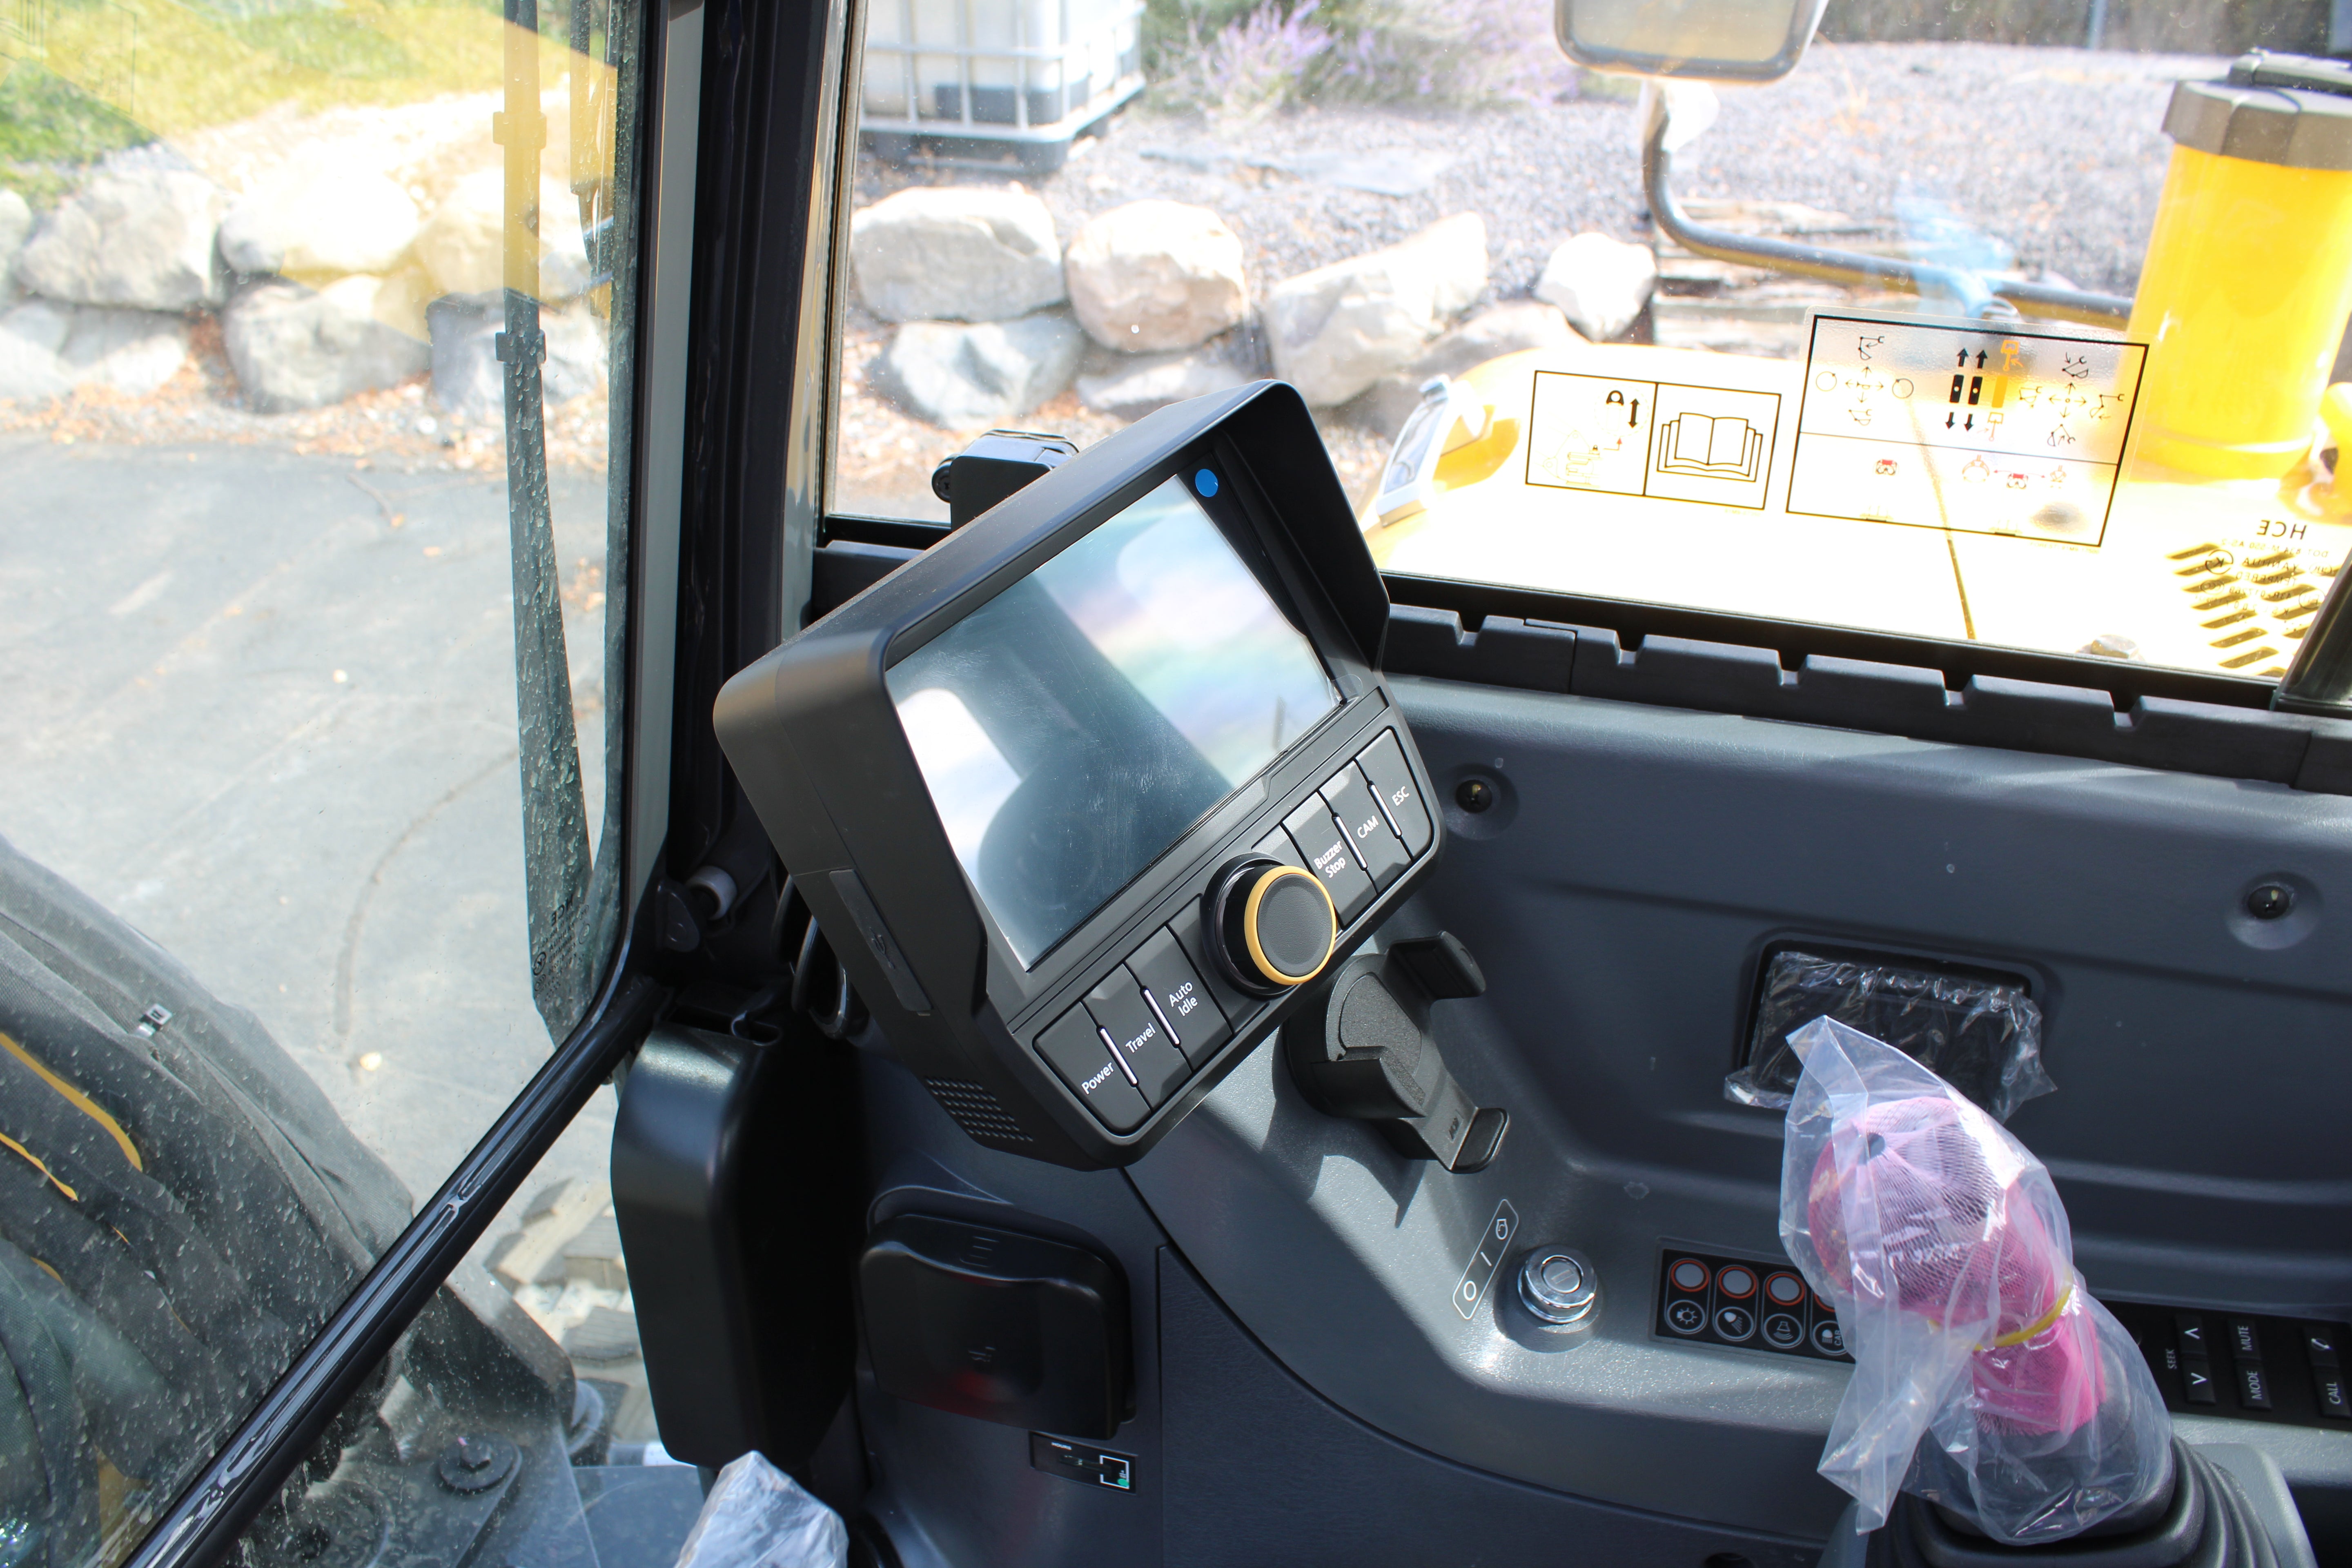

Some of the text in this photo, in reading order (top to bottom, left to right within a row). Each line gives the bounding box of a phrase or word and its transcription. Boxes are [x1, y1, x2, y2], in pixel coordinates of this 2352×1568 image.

[1392, 786, 1410, 806] ESC
[1357, 815, 1379, 838] CAM
[1314, 840, 1343, 870] Buzzer
[1325, 857, 1346, 878] Stop
[1169, 982, 1193, 1007] Auto
[1178, 996, 1198, 1017] Idle
[1125, 1022, 1156, 1054] Travel
[1081, 1062, 1114, 1095] Power
[2237, 1325, 2252, 1351] MUTE
[2166, 1348, 2177, 1370] SEEK
[2247, 1370, 2263, 1400] MODE
[2326, 1381, 2342, 1405] CALL
